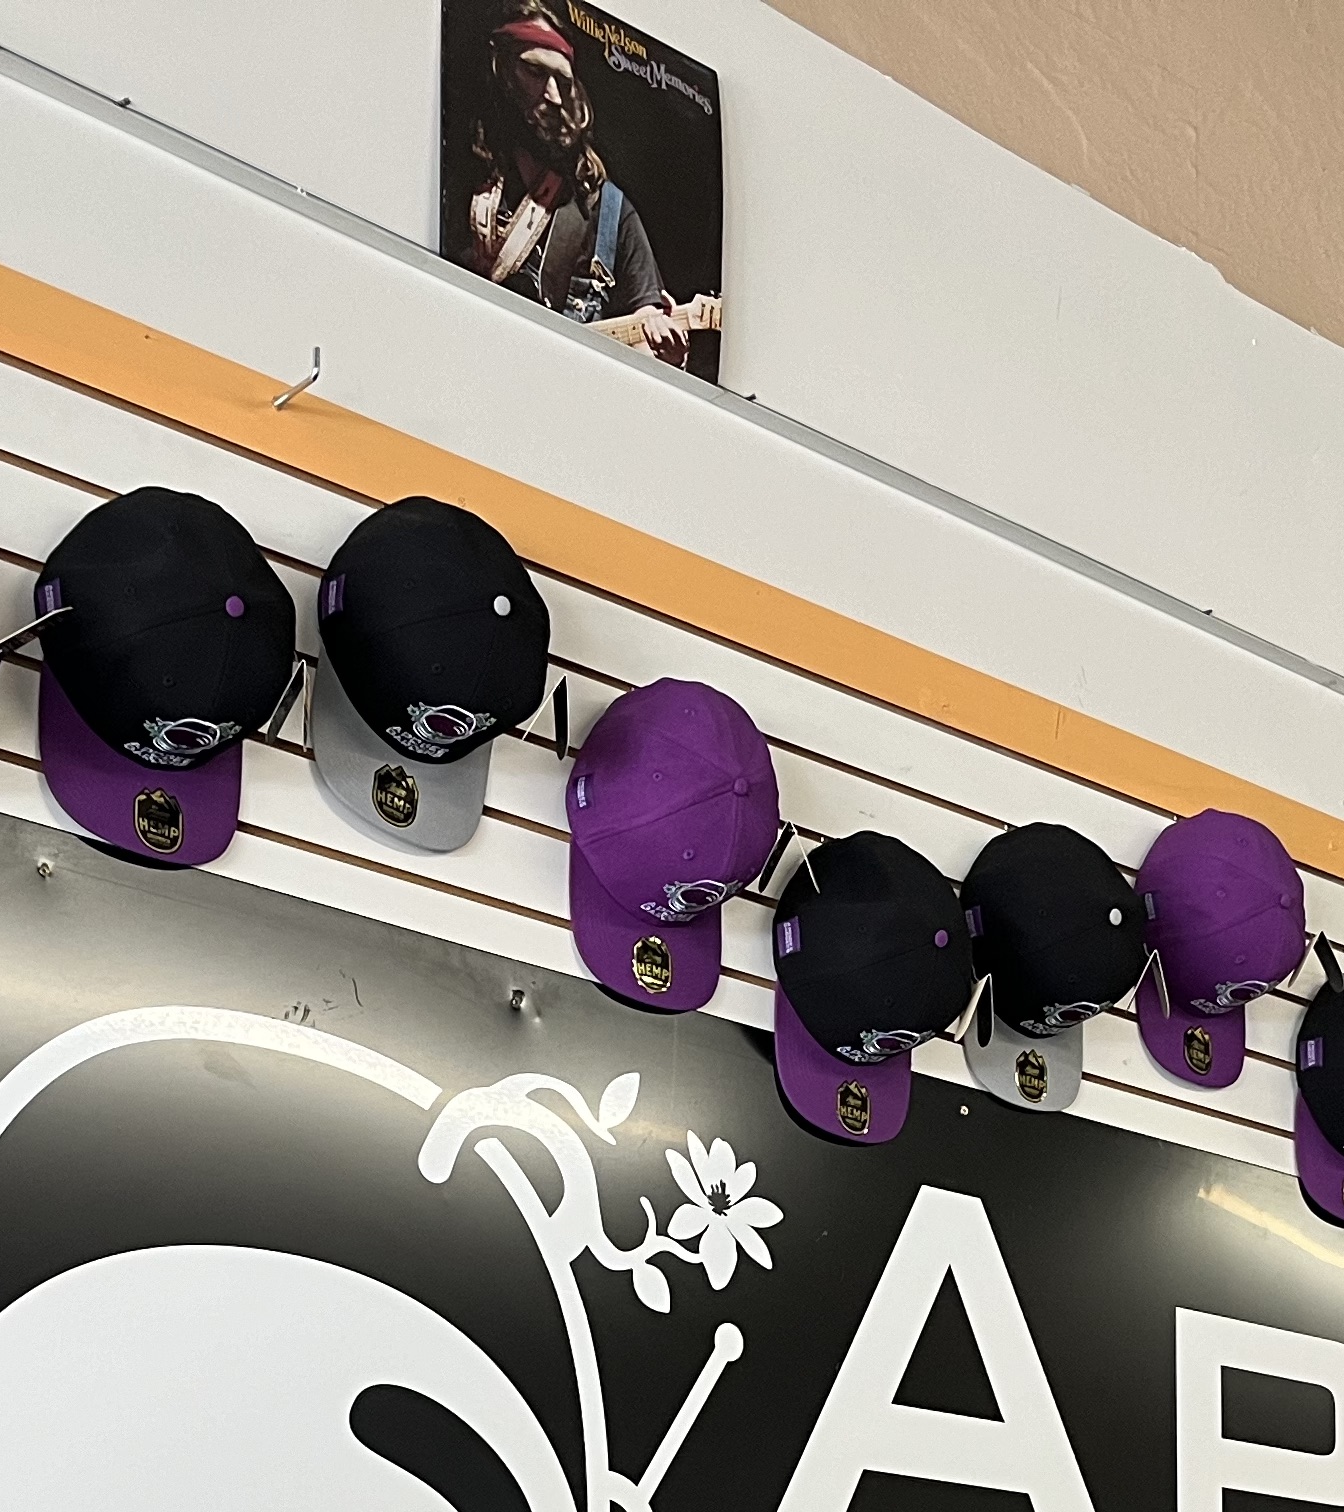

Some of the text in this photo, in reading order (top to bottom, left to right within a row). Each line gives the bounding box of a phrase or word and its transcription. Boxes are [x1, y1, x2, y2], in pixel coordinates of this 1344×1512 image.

[567, 0, 648, 61] Willie Nelson
[607, 44, 713, 115] Sweet Memories
[375, 789, 413, 815] HEMP
[637, 962, 670, 981] HEMP
[840, 1105, 869, 1123] HEMP
